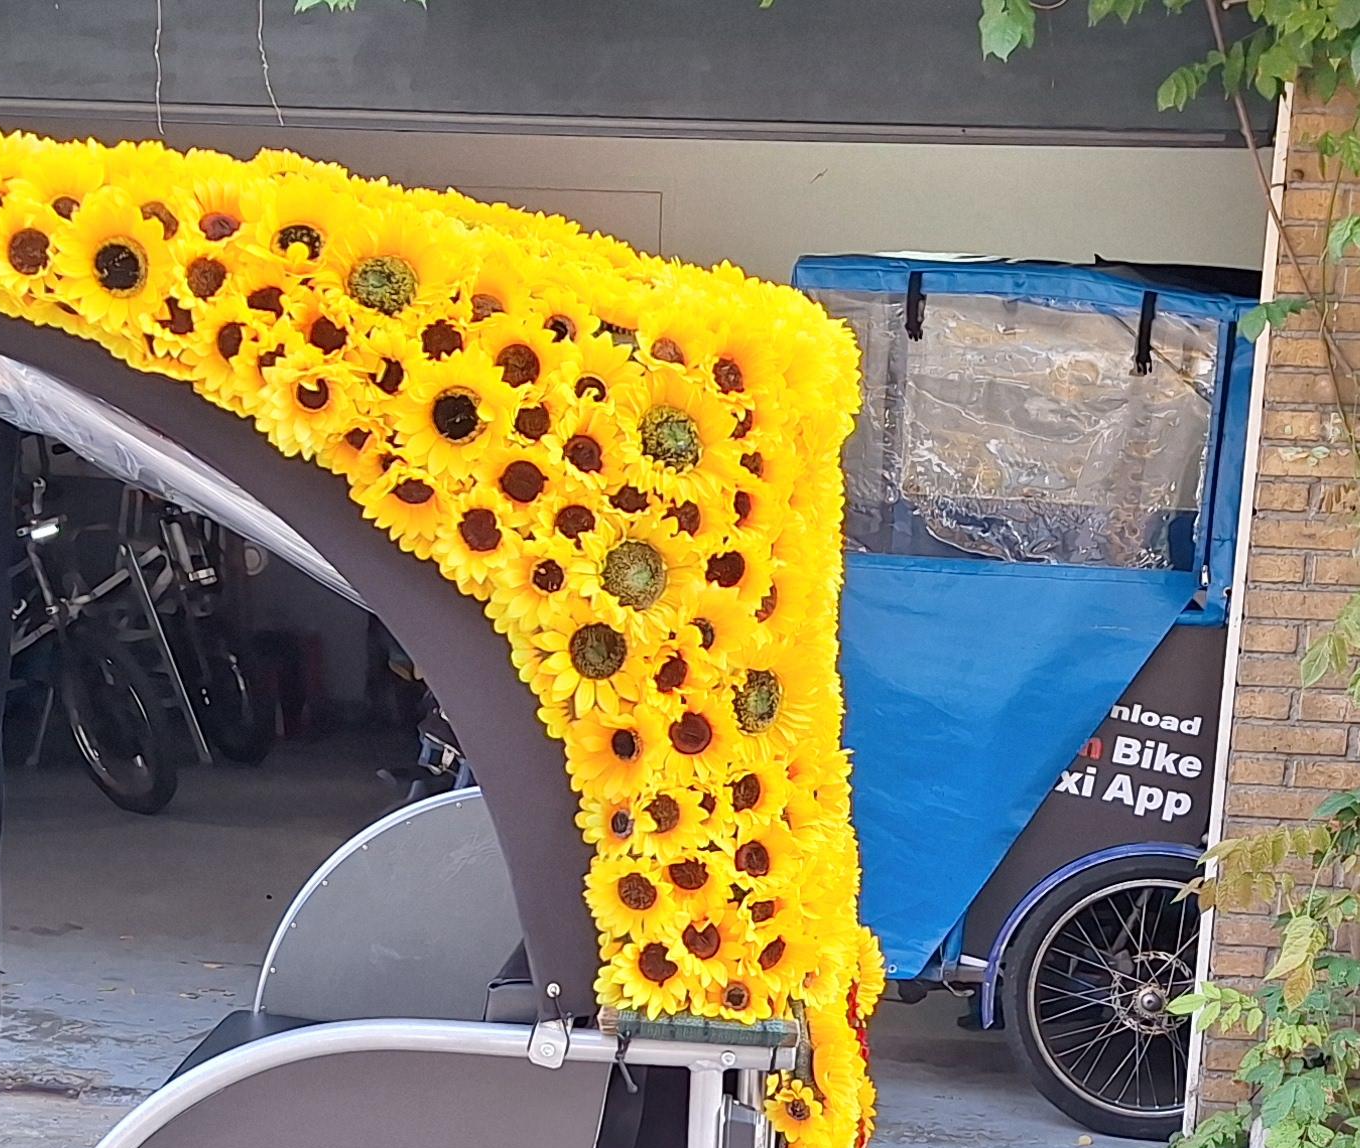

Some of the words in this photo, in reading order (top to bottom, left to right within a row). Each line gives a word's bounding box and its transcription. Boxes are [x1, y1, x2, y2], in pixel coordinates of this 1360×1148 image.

[1110, 703, 1202, 736] nload
[1112, 735, 1203, 779] Bike
[1055, 765, 1098, 798] xi
[1102, 773, 1192, 822] App
